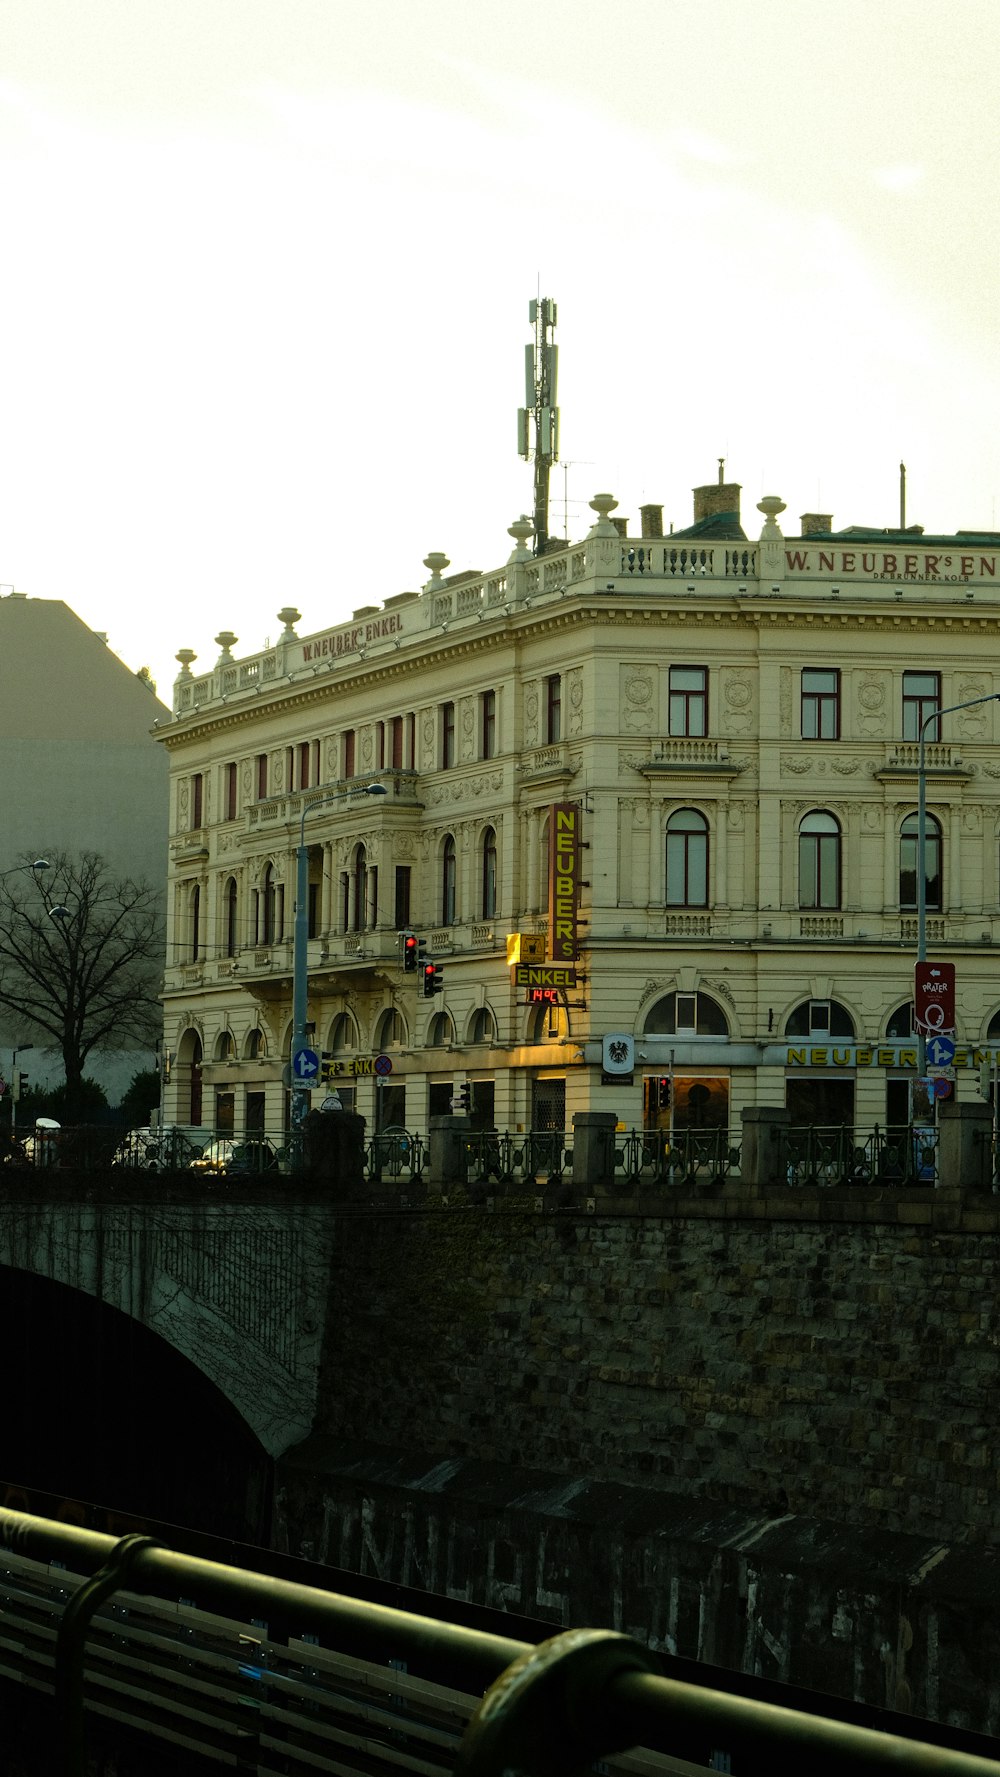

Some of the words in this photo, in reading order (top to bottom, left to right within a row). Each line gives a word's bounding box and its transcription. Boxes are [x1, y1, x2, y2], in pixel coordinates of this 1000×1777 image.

[785, 551, 811, 571] W.
[873, 572, 888, 580] DR.
[889, 573, 937, 582] BRUNNER
[365, 614, 403, 642] ENKEL
[556, 810, 575, 956] NEUBERS
[517, 969, 575, 986] ENKEL
[922, 981, 948, 993] PRATER
[533, 990, 543, 1001] 14
[952, 1051, 1000, 1067] EN
